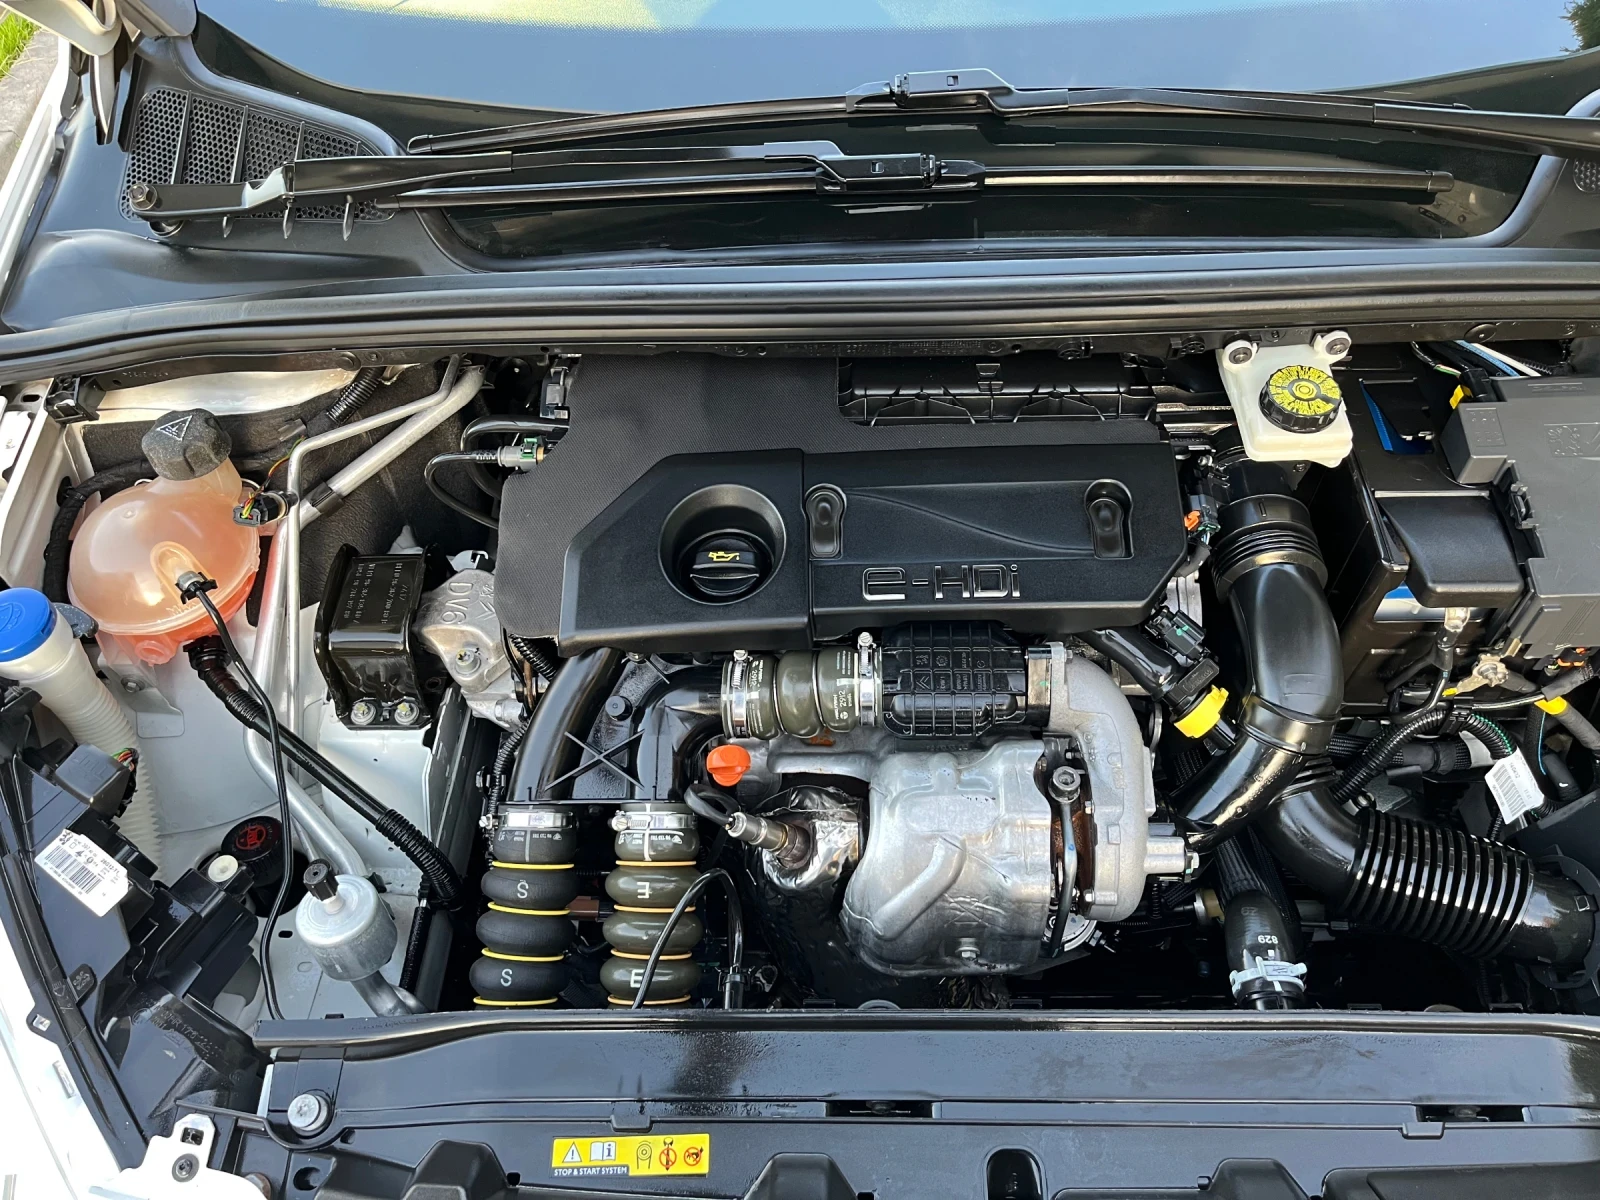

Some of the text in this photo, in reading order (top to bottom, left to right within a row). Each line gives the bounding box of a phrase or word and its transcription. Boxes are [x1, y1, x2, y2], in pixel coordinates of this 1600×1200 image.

[862, 564, 1021, 601] e-HDi
[441, 582, 473, 625] DV6
[1258, 934, 1279, 944] 829
[500, 968, 513, 987] S
[630, 969, 644, 988] E
[554, 1168, 572, 1176] STOP
[579, 1167, 600, 1175] START
[602, 1167, 627, 1175] SYSTEM
